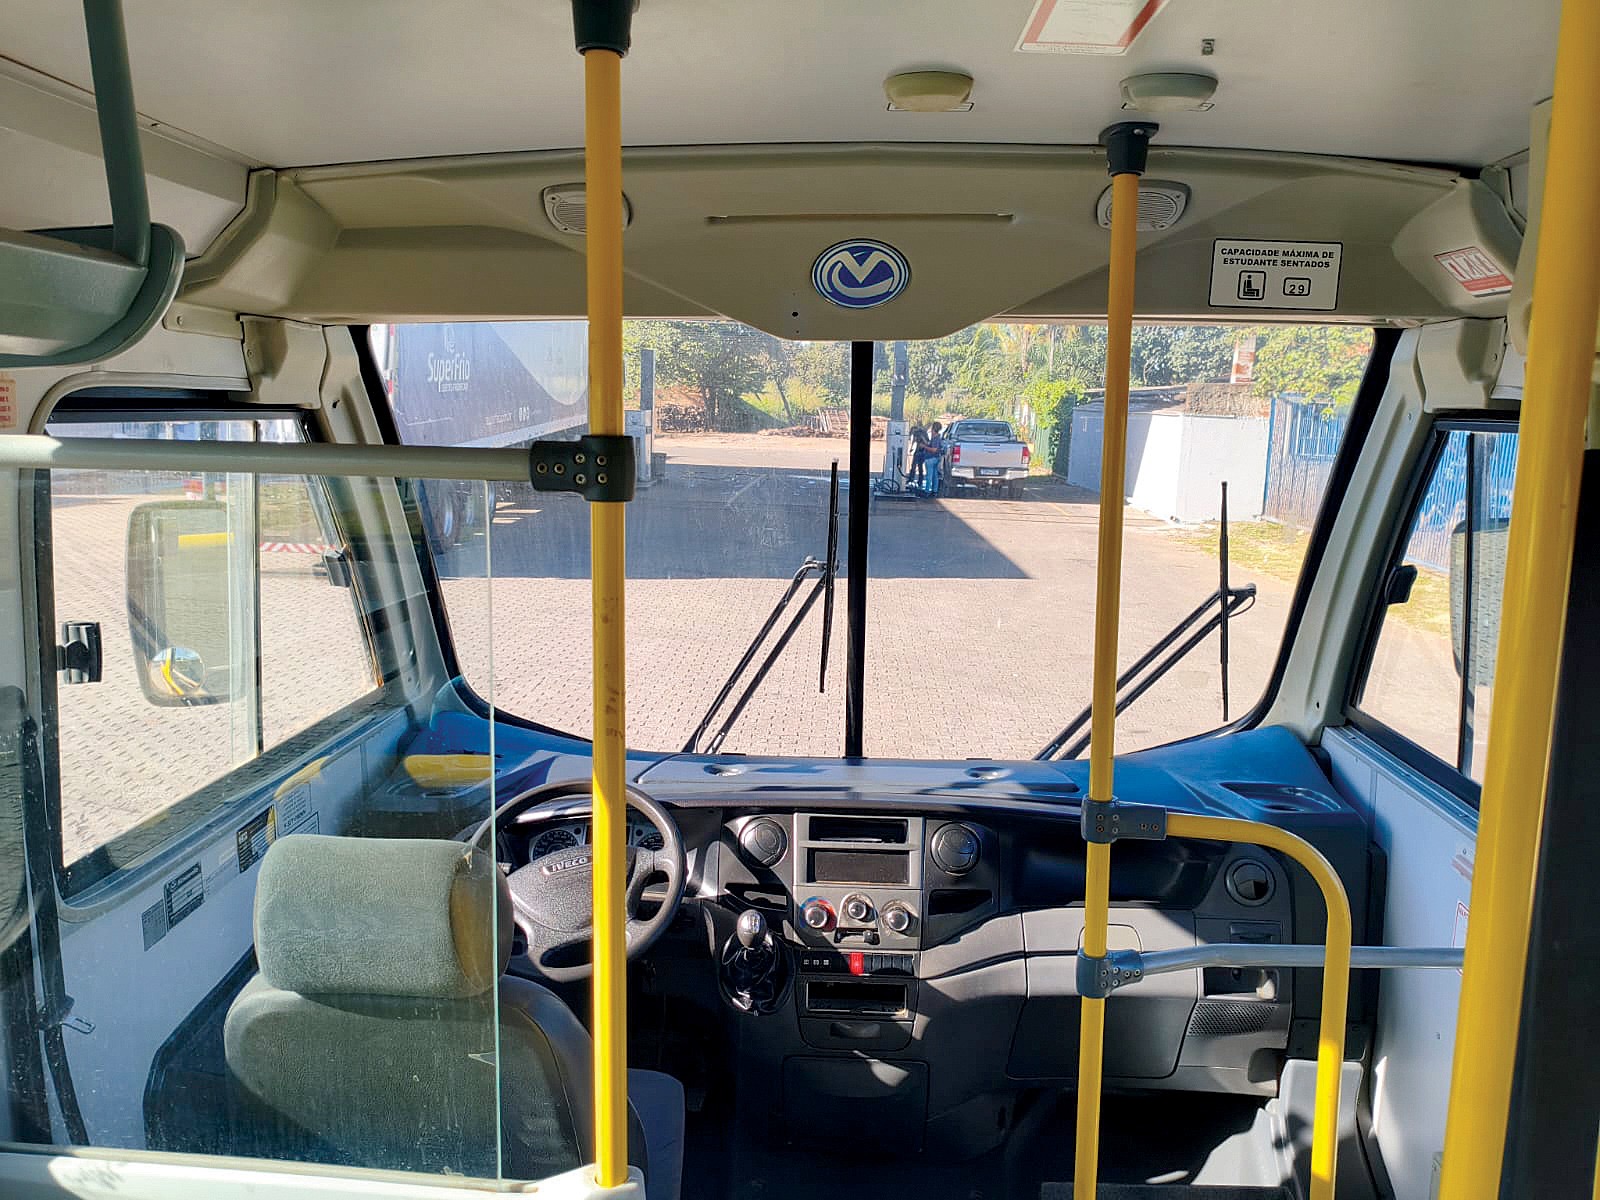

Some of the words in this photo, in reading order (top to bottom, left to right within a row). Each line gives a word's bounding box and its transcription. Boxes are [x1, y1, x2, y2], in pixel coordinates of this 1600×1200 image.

[1221, 248, 1280, 257] CAPACIDADE
[1281, 249, 1320, 259] MÁXIMA
[1322, 251, 1335, 259] DE
[1223, 257, 1278, 267] ESTUDANTE
[1280, 259, 1330, 268] SENTADOS
[1288, 284, 1305, 294] 29
[427, 352, 471, 389] SuperFrio
[550, 856, 588, 872] IVECO
